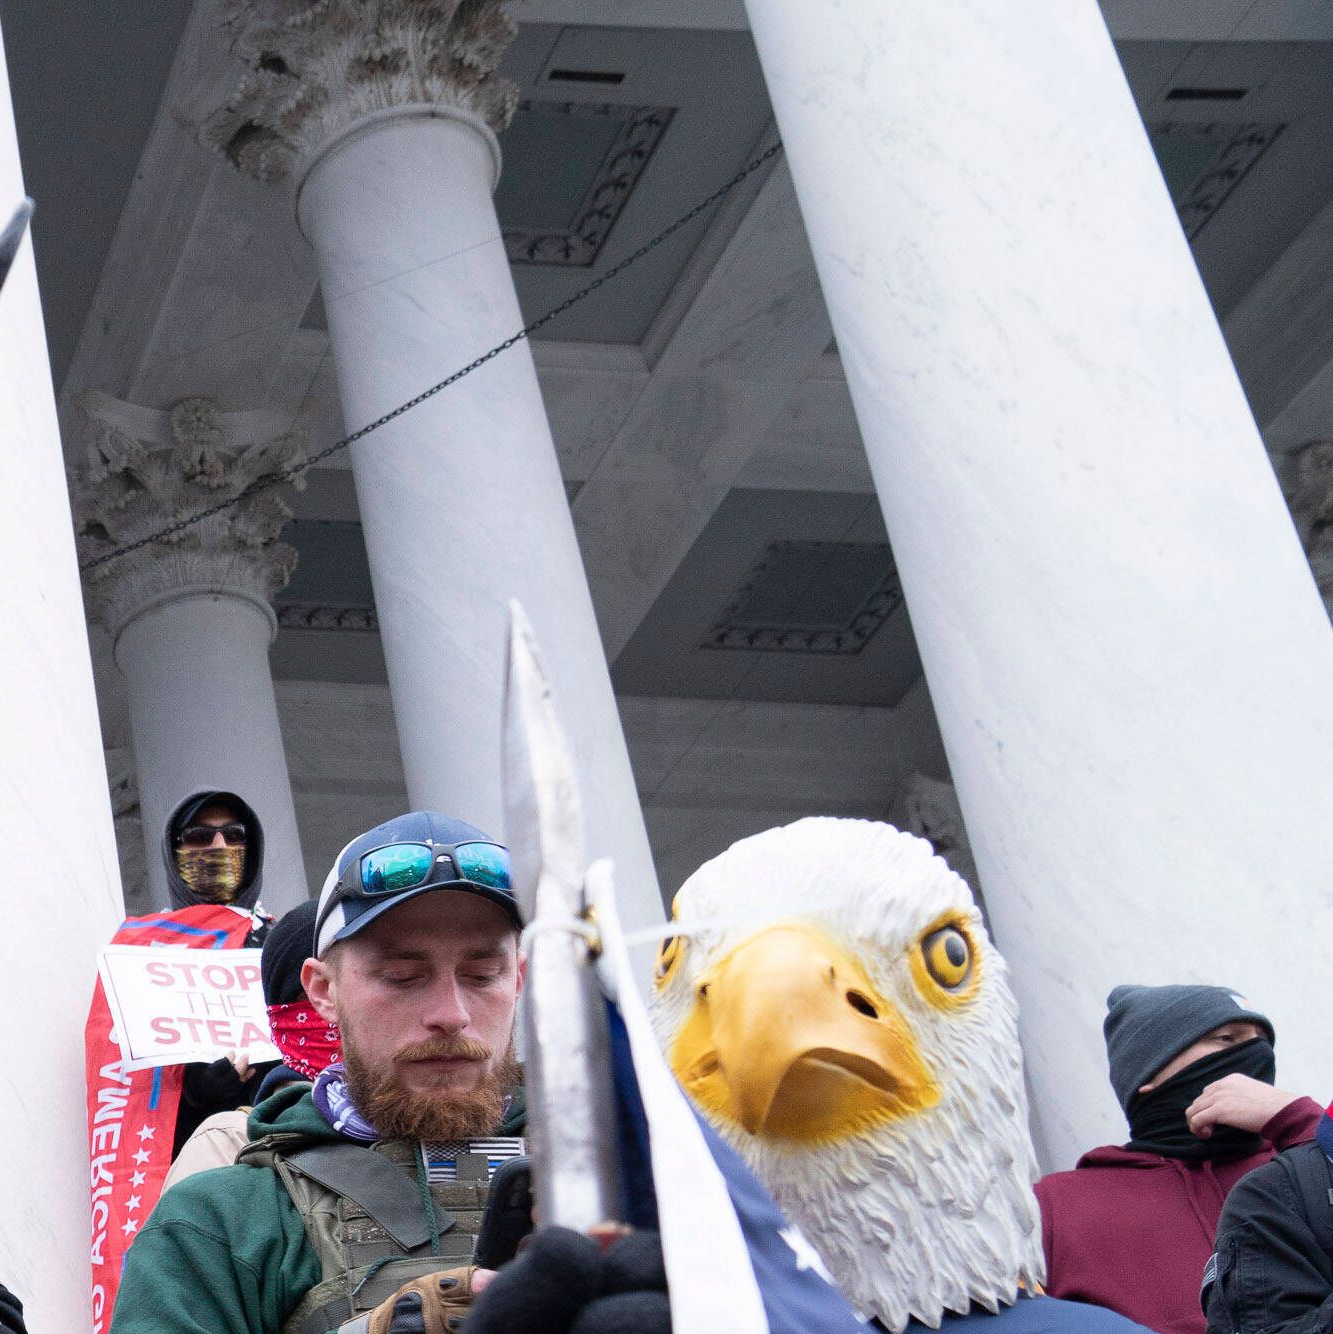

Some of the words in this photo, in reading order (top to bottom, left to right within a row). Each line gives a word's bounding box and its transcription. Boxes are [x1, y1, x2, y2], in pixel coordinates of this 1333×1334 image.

[145, 962, 262, 991] STOP
[177, 991, 254, 1019] THE
[150, 1016, 272, 1049] STEA
